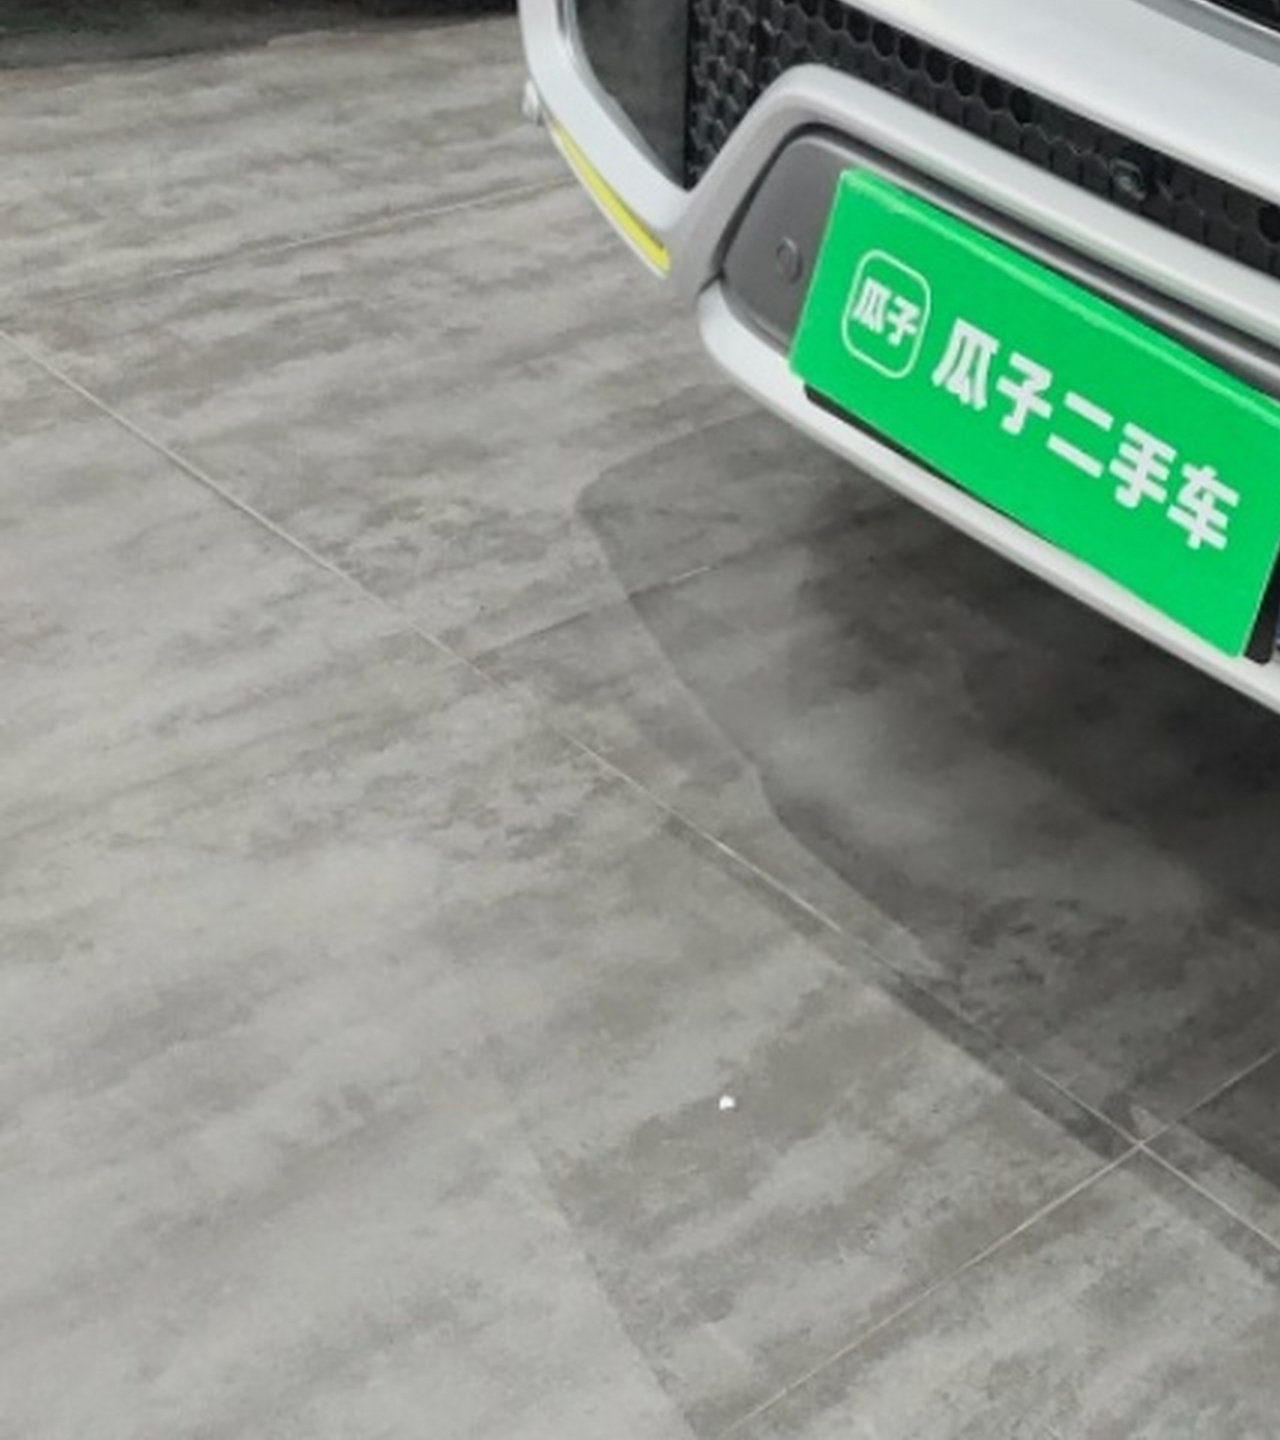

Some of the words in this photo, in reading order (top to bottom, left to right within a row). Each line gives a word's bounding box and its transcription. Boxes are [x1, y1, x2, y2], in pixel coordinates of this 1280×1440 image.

[852, 276, 921, 346] 瓜子
[931, 318, 1240, 550] 瓜子二手车
